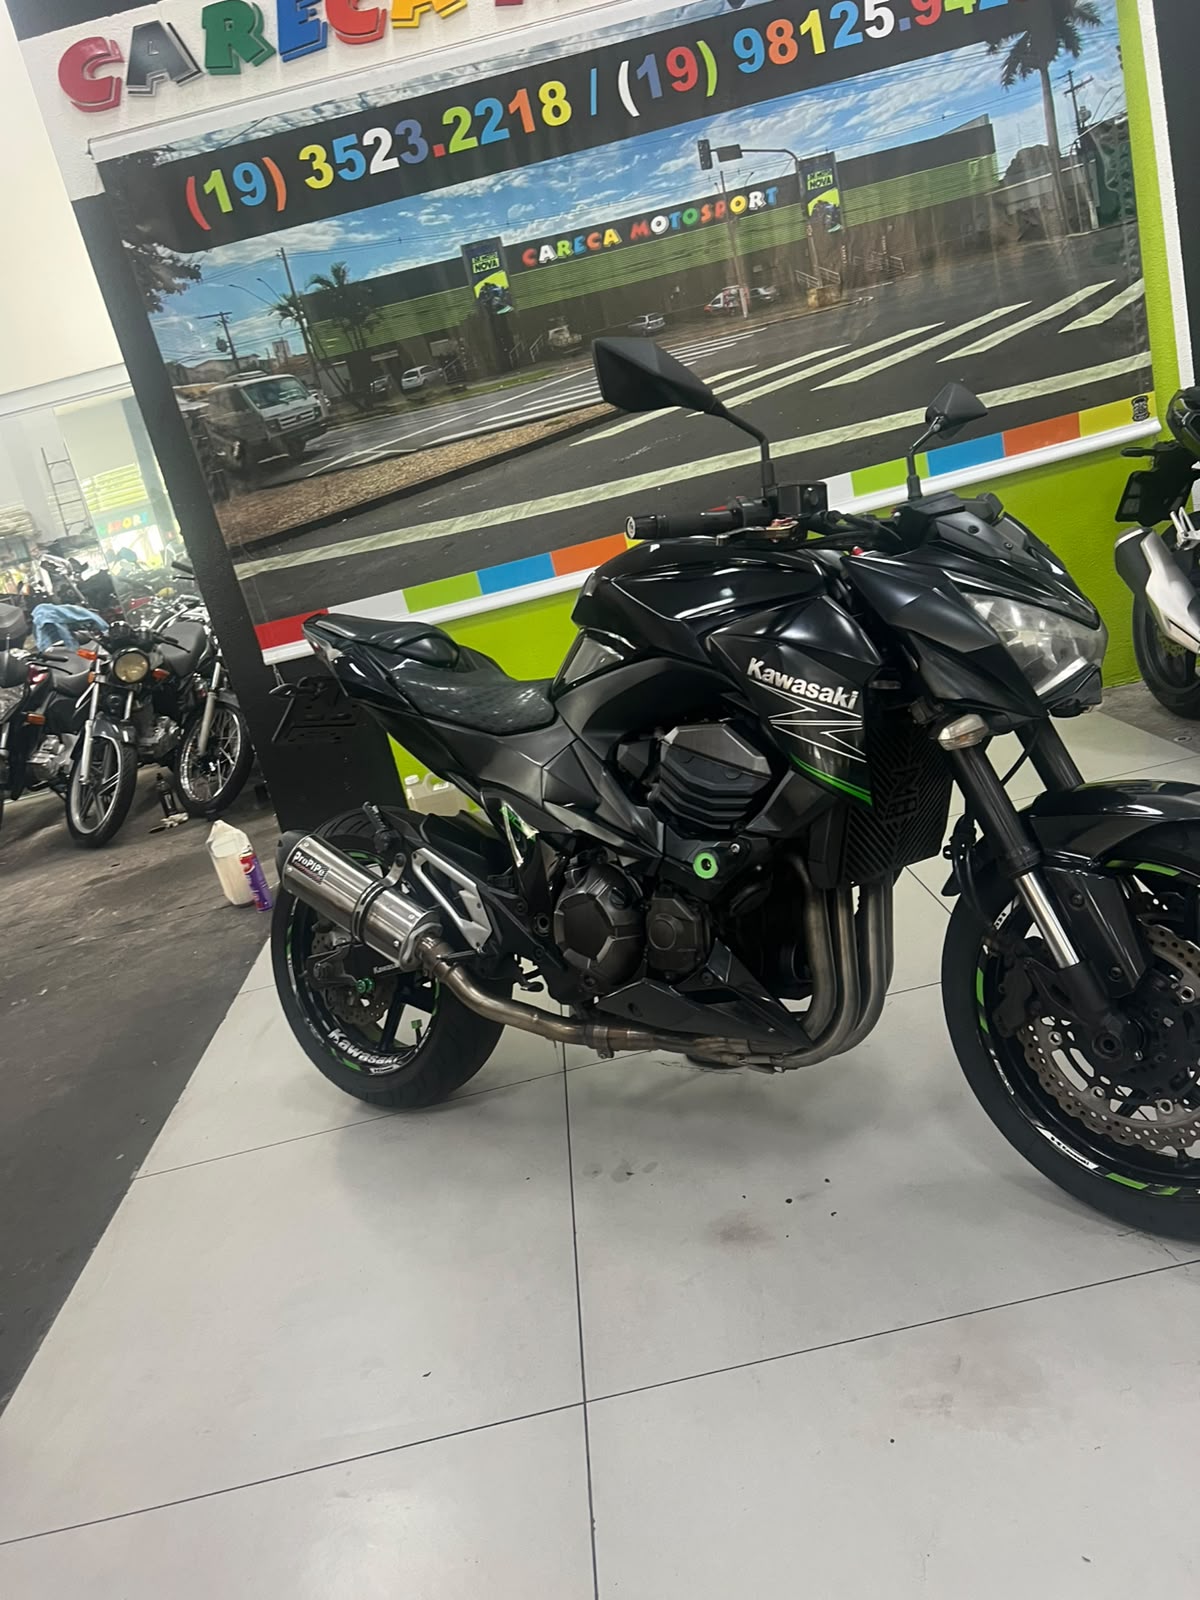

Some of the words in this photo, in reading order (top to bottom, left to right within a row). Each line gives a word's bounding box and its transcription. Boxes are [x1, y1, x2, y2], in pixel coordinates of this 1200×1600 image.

[186, 157, 287, 231] (19)
[299, 80, 572, 190] 3523.2218
[617, 41, 718, 118] (19)
[522, 228, 622, 268] CARECA
[630, 186, 779, 241] MOTOSPORT
[746, 657, 860, 710] Kawasaki
